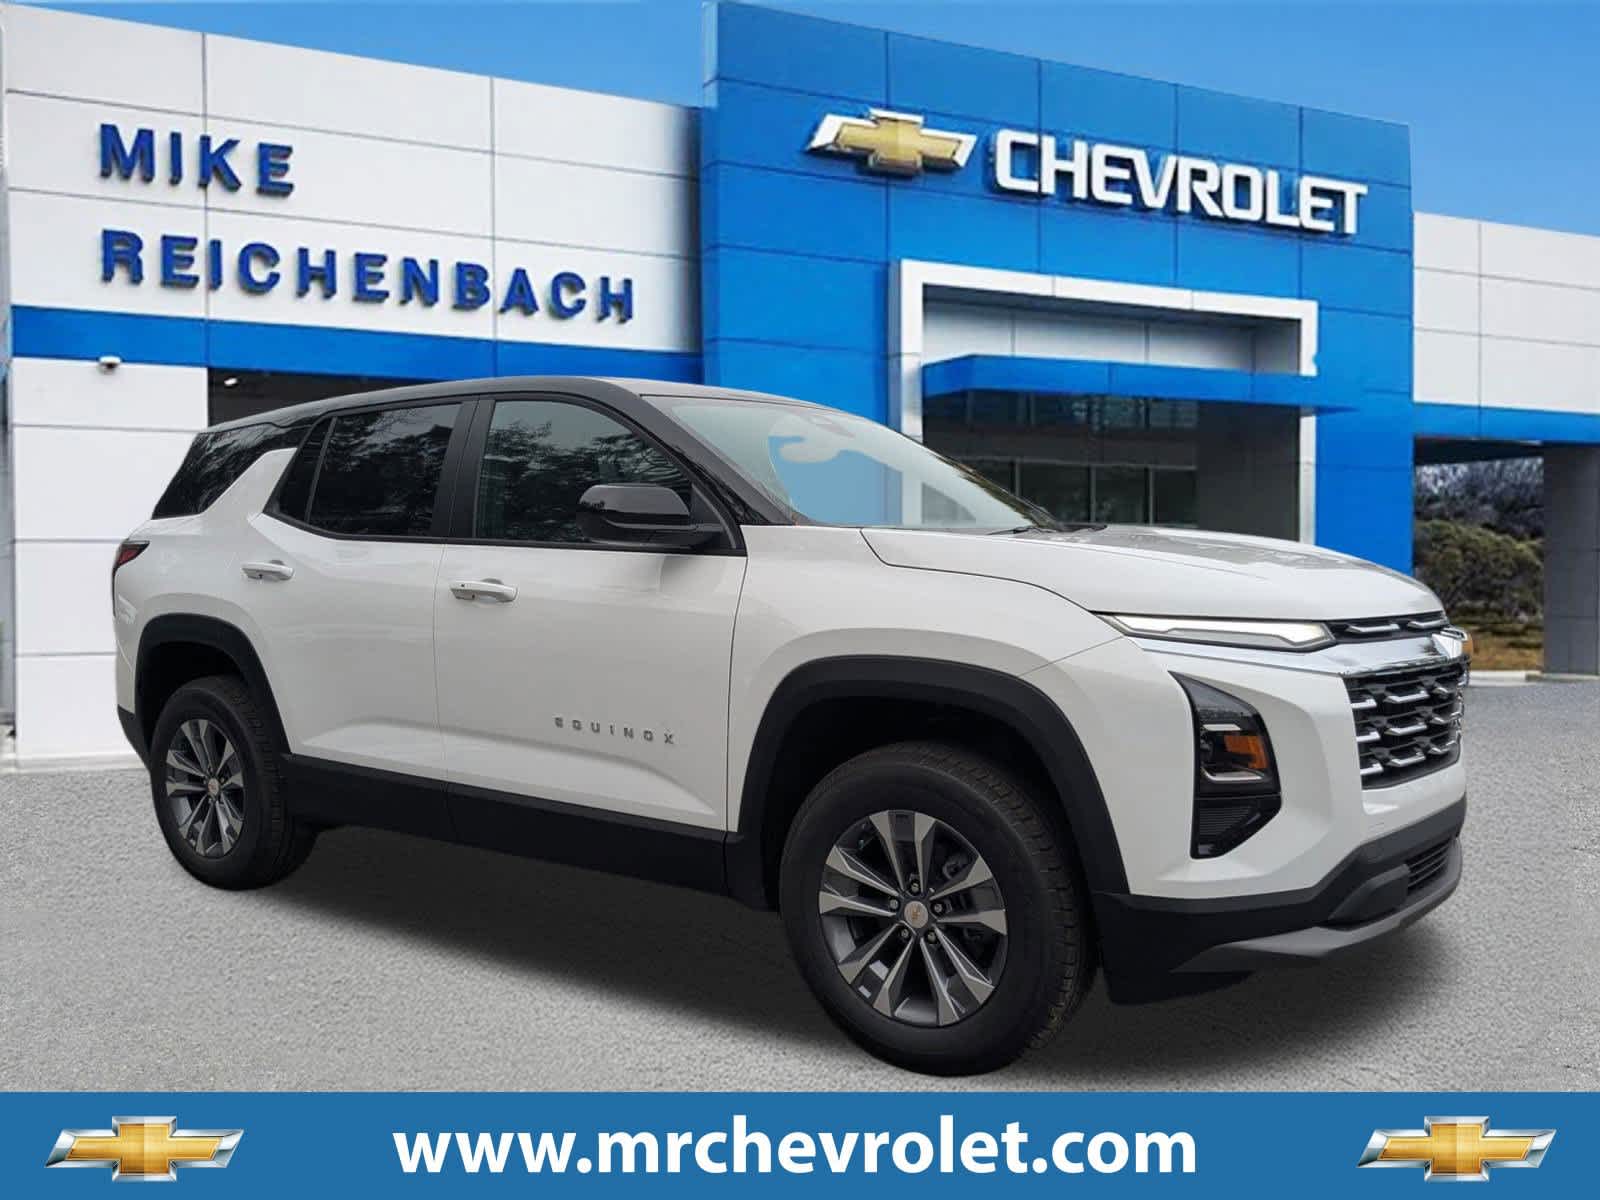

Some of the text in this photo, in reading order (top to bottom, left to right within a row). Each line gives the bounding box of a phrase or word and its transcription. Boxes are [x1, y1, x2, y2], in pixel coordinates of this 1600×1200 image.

[100, 123, 295, 197] MIKE
[994, 129, 1368, 235] CHEVROLET
[101, 229, 635, 324] REICHENBACH
[554, 716, 675, 745] EQUINOX
